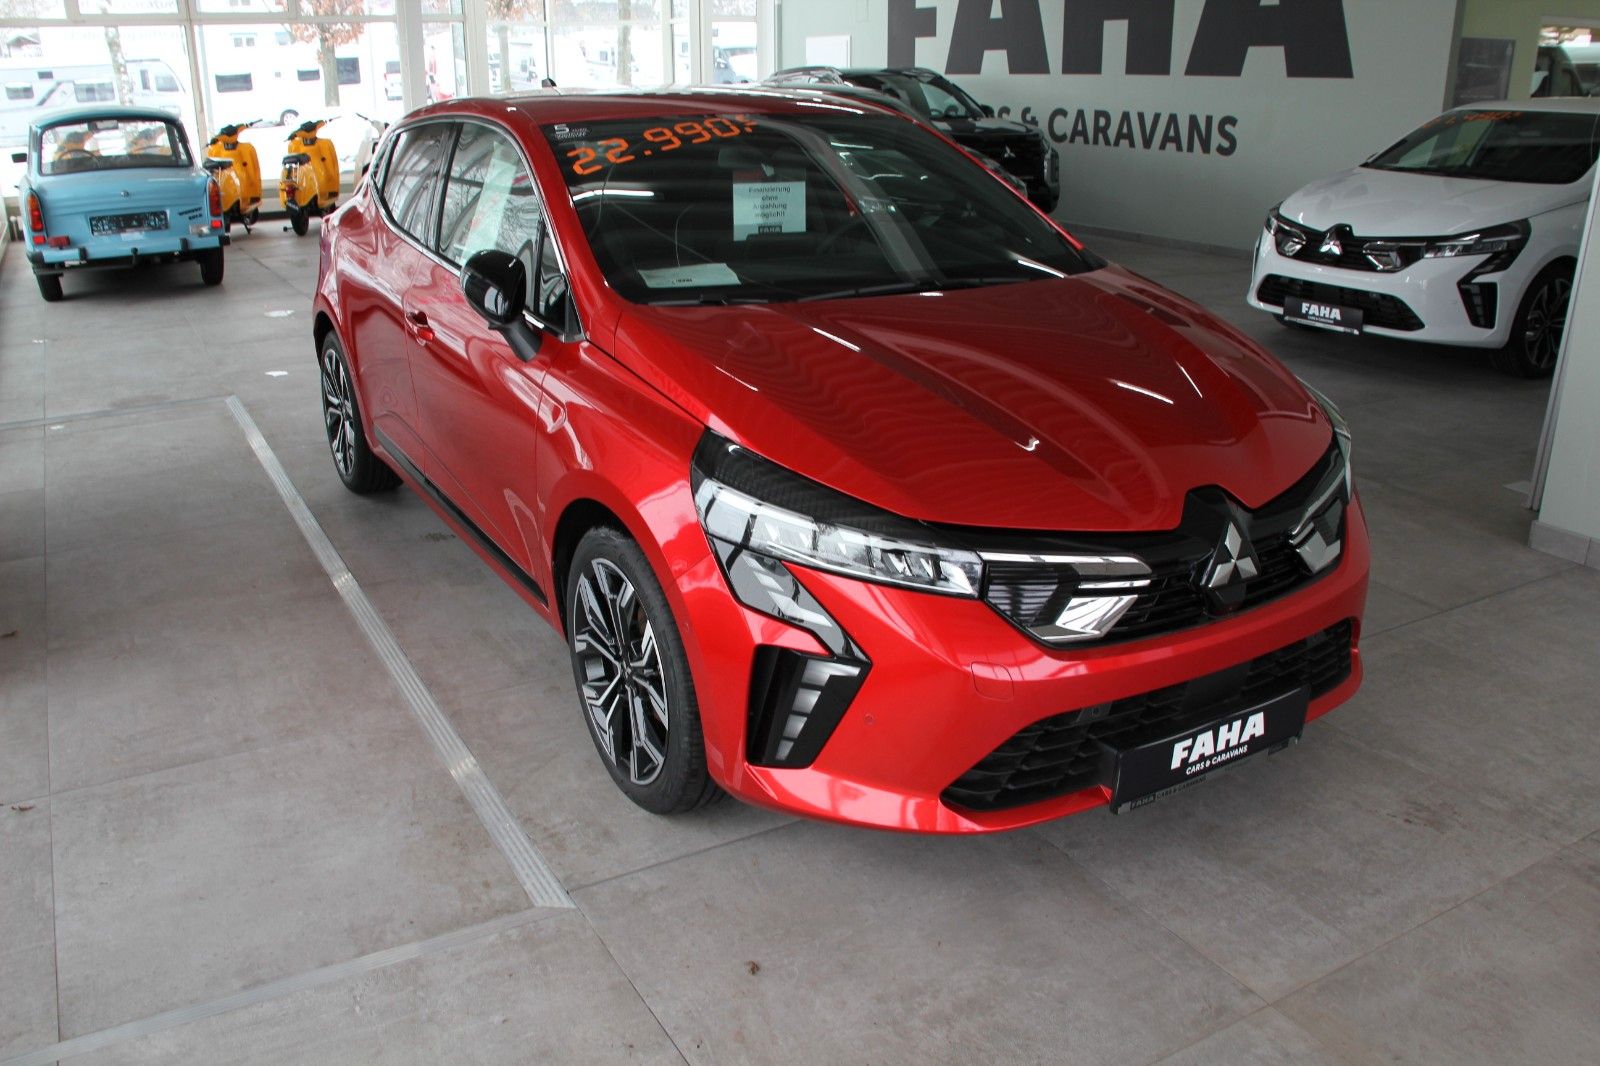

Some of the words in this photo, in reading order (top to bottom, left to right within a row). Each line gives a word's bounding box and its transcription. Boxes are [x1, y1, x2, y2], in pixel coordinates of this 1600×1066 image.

[1048, 107, 1239, 157] CARAVANS
[753, 203, 788, 211] Anzahlung
[761, 194, 779, 202] ohne
[1302, 302, 1341, 320] FAHA
[1171, 712, 1265, 770] FAHA
[1186, 761, 1205, 775] CARS
[1211, 744, 1248, 766] CARAVANS
